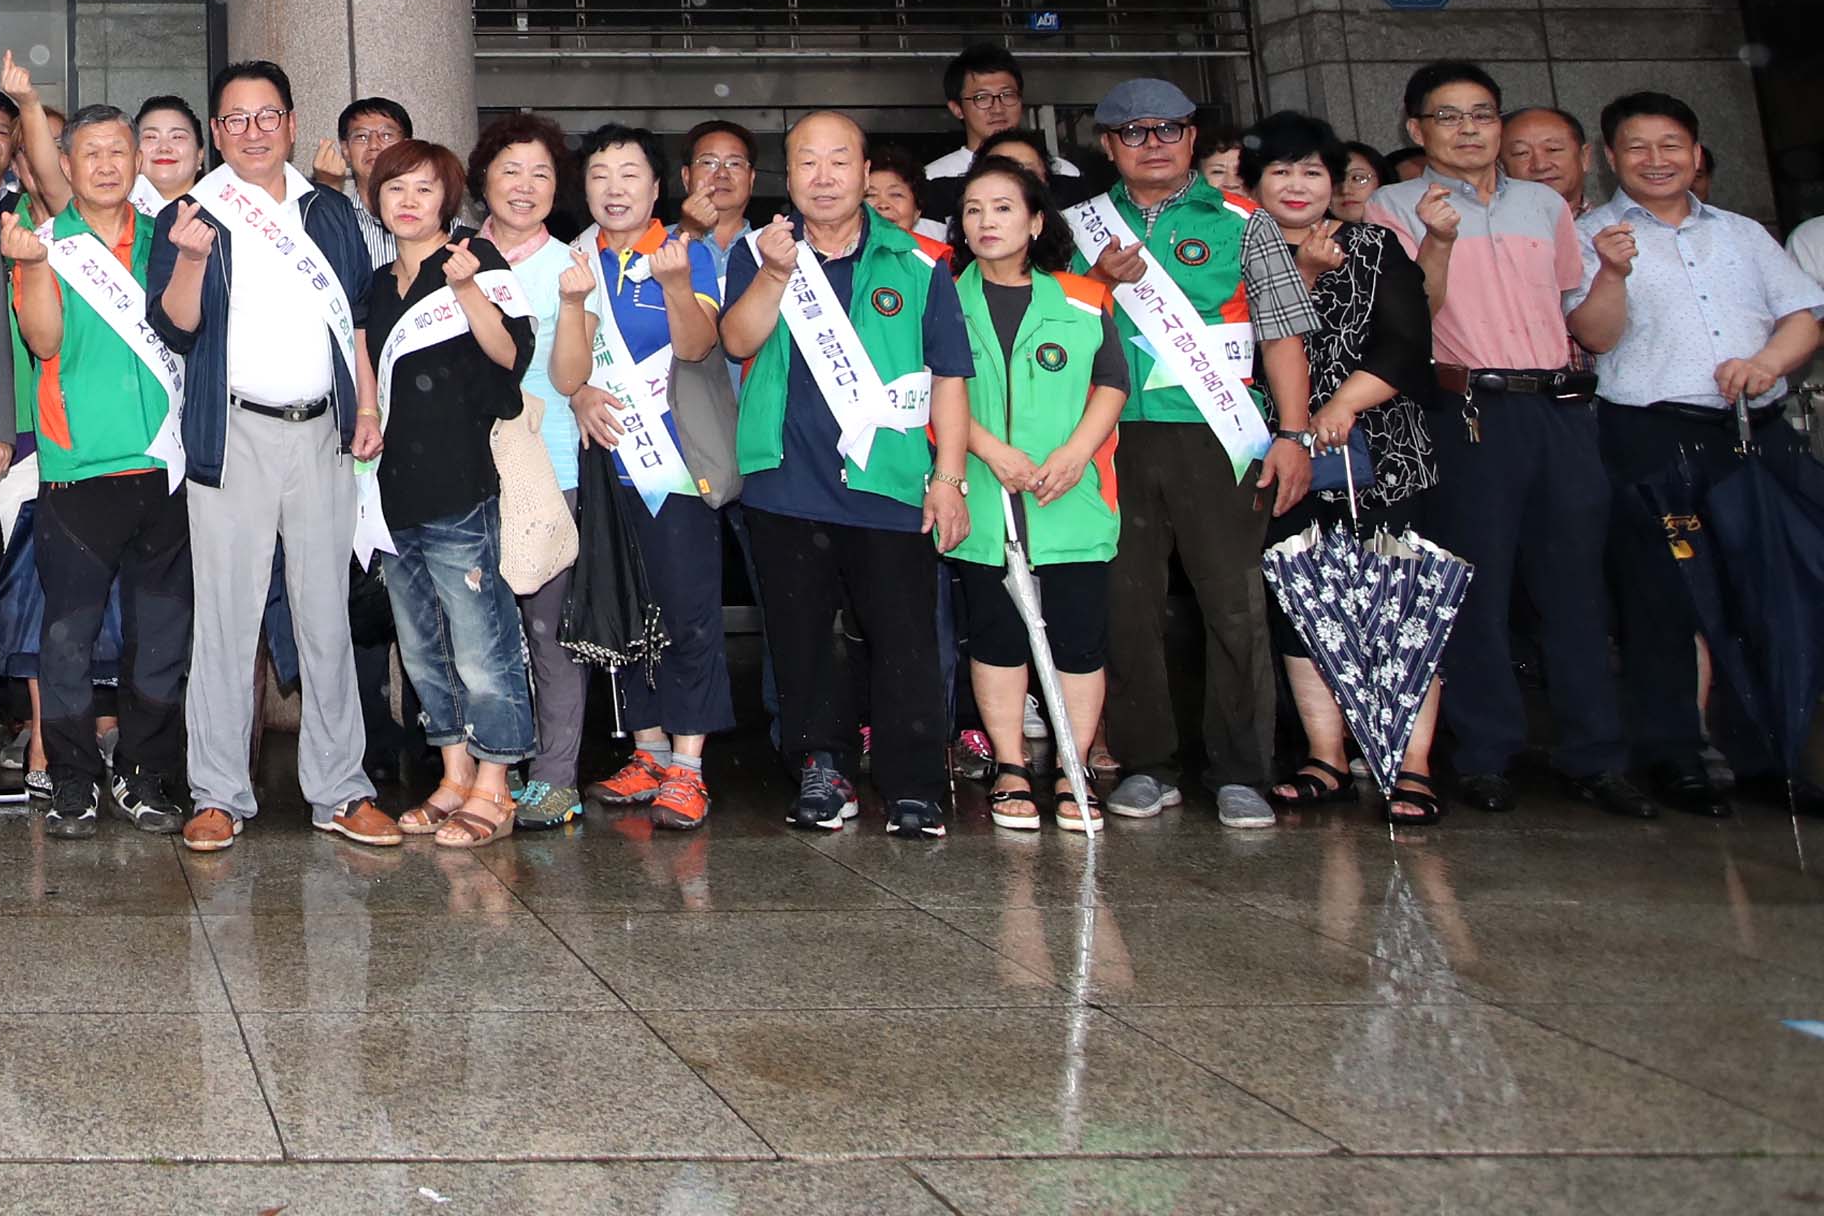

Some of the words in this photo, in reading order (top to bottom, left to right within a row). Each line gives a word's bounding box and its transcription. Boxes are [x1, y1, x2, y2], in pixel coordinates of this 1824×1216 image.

[1036, 13, 1057, 26] ADT
[219, 184, 296, 255] 물가안정을
[297, 257, 330, 290] 위해
[80, 259, 133, 312] 장보기로
